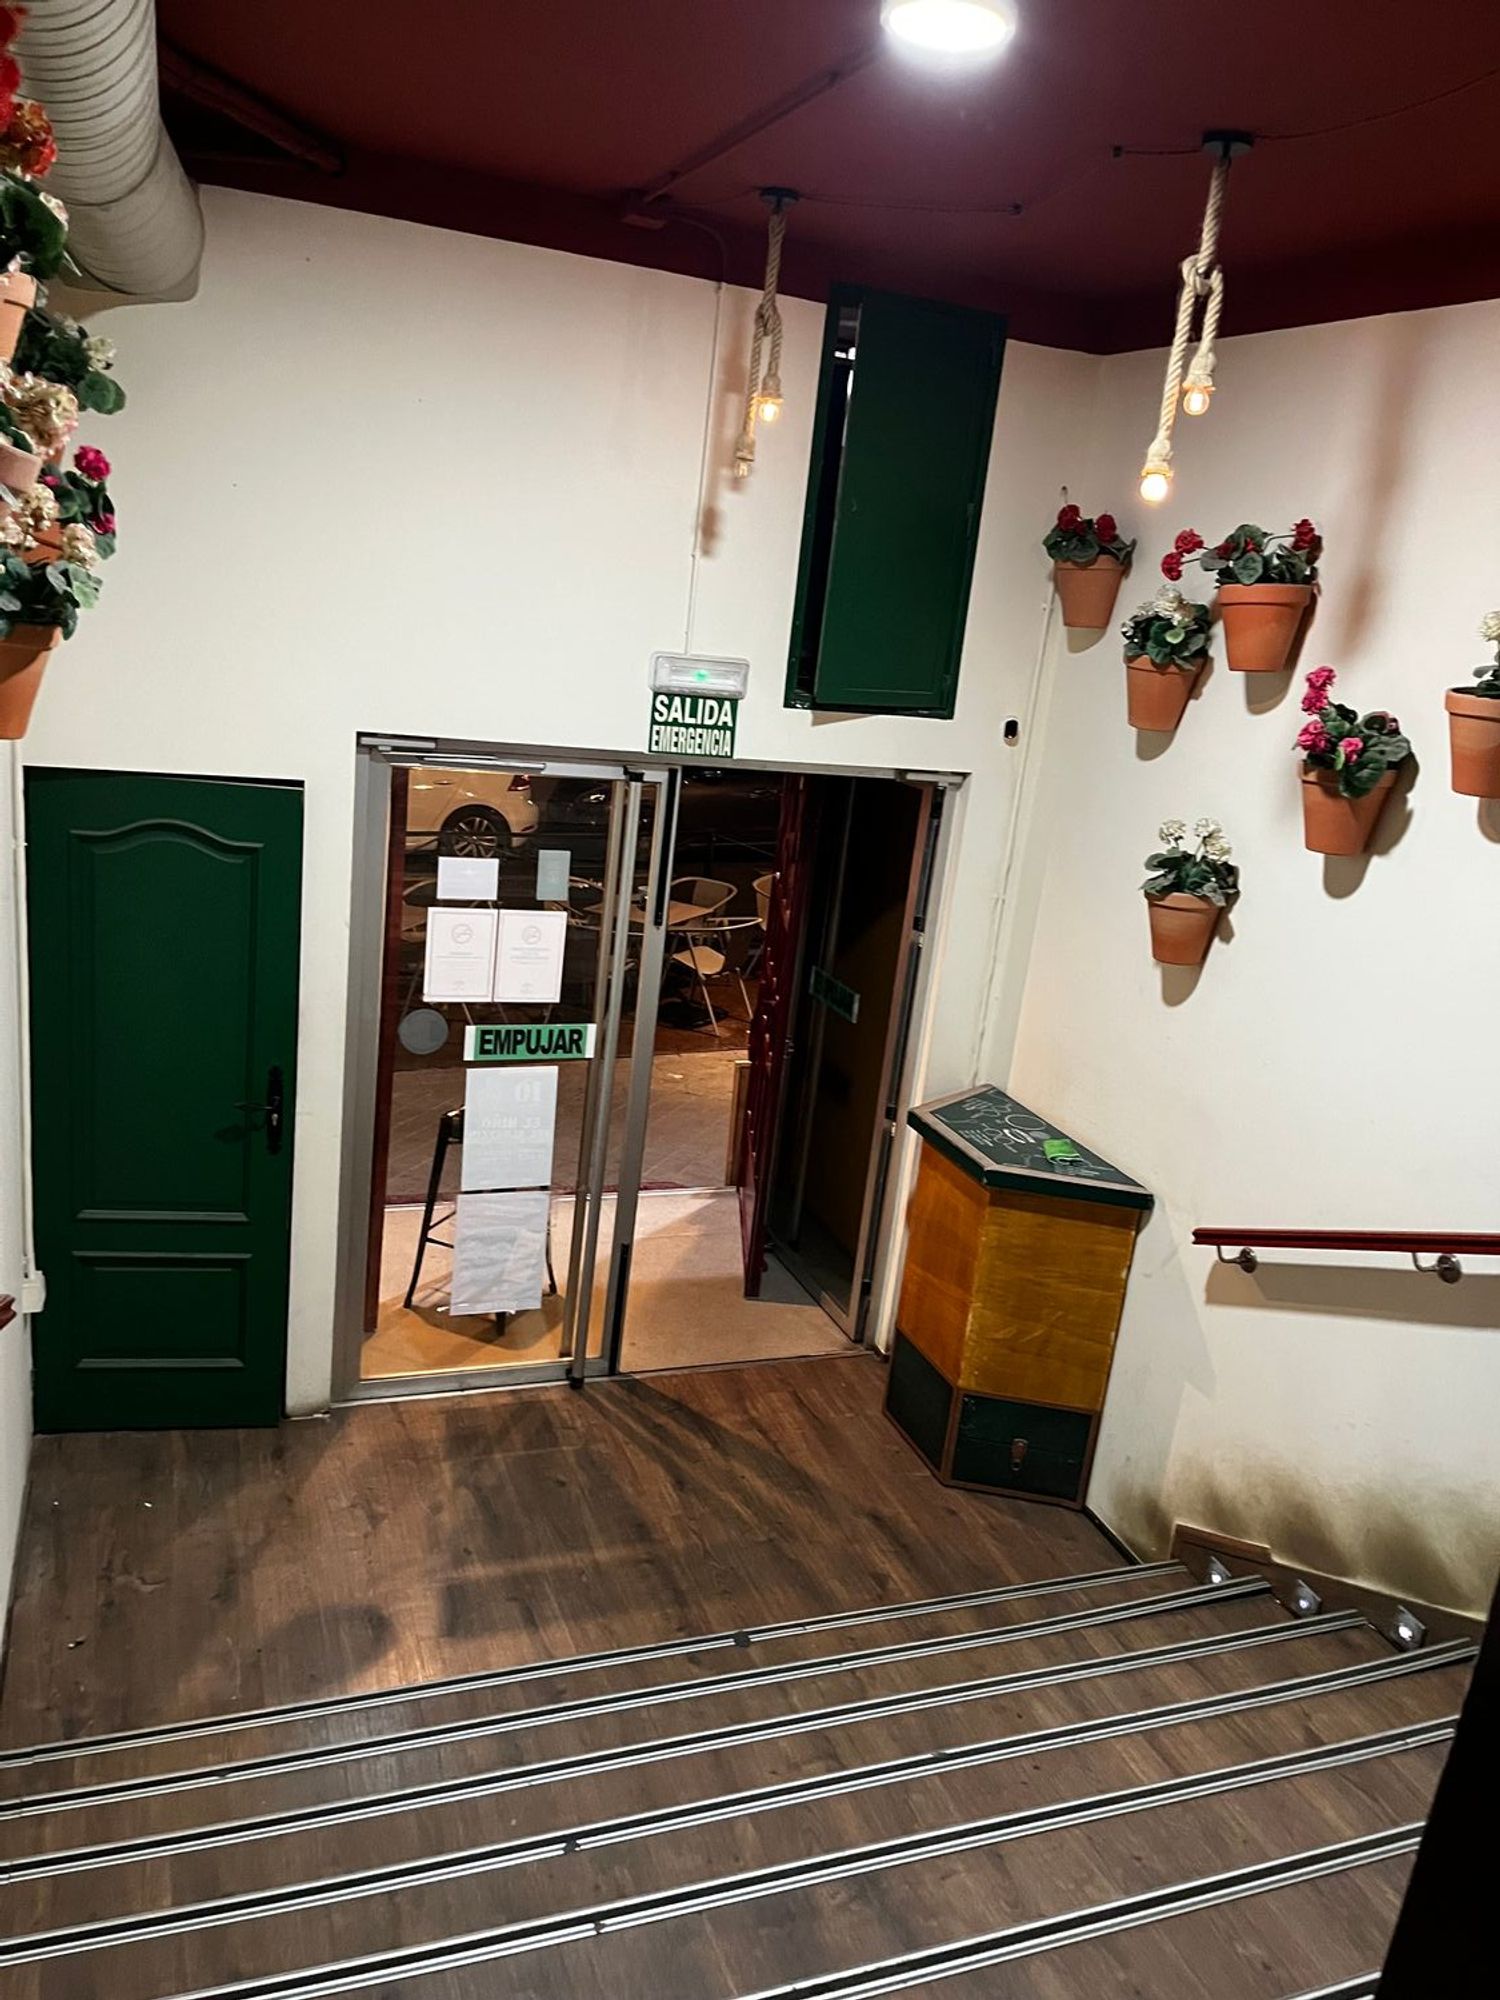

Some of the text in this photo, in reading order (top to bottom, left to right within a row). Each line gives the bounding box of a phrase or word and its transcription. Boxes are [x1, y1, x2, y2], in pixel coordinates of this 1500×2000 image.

[654, 694, 733, 726] SALIDA
[651, 725, 731, 756] EMERGENCIA
[479, 1029, 583, 1055] EMPUJAR
